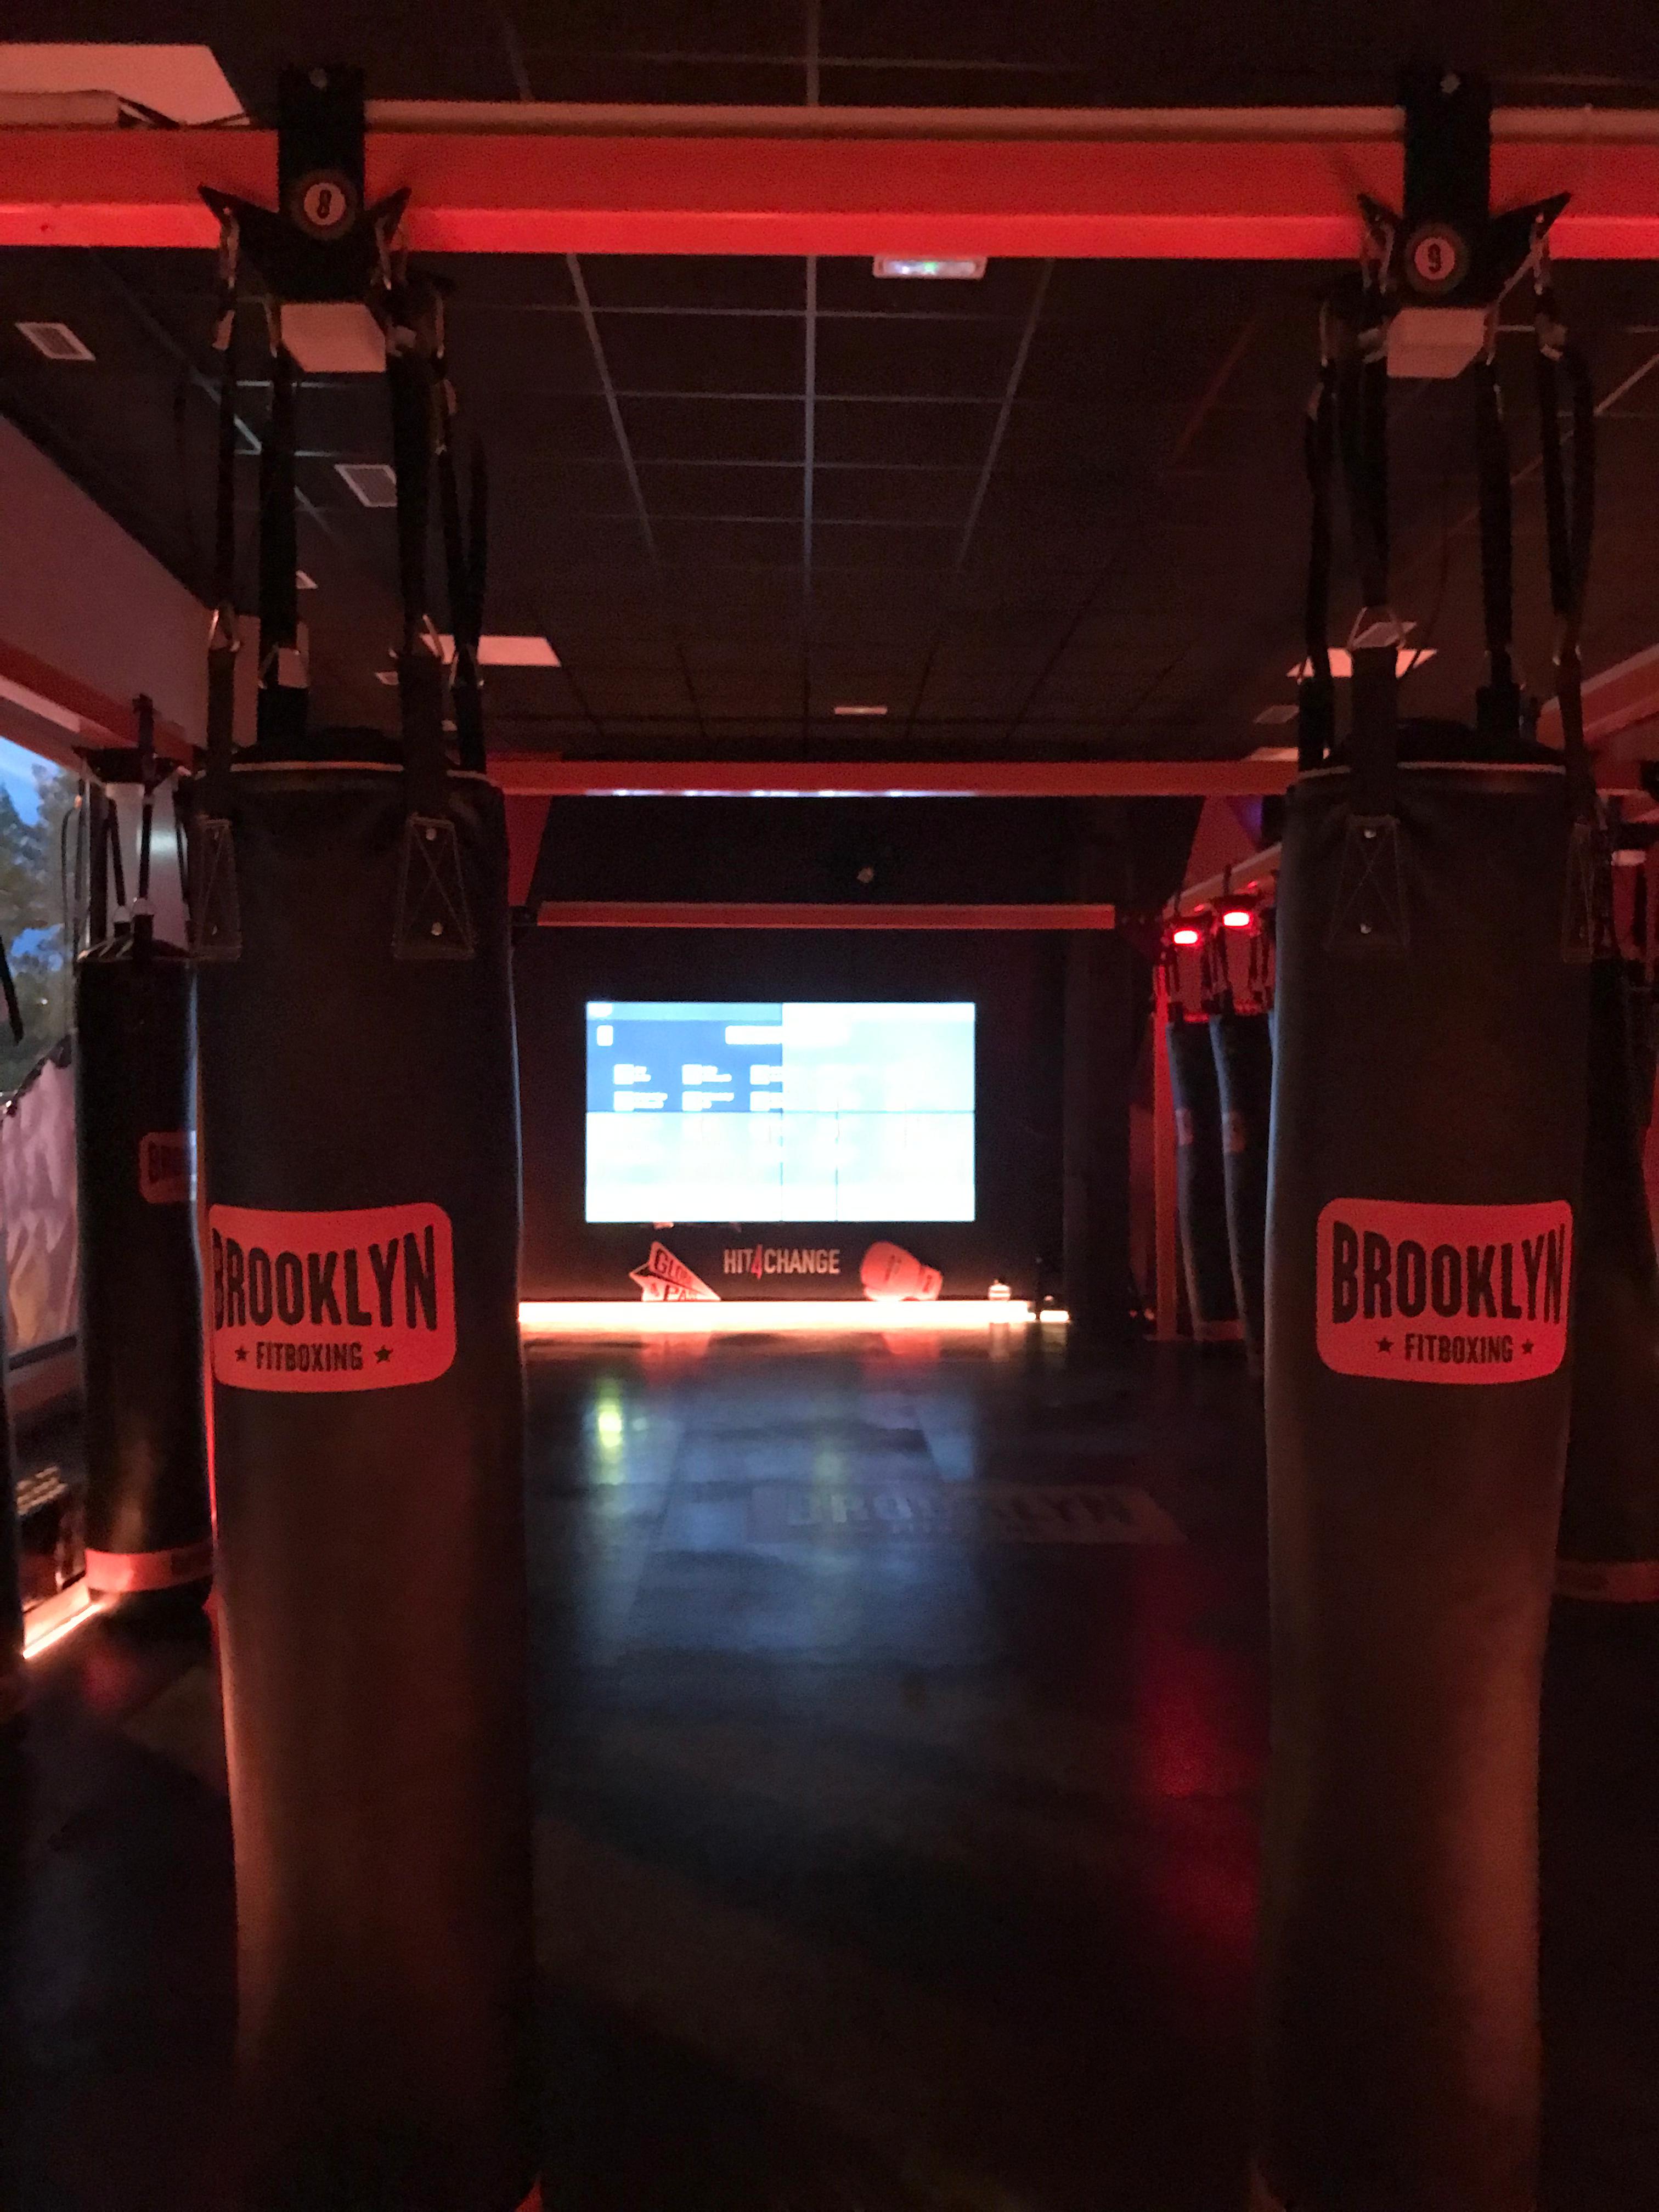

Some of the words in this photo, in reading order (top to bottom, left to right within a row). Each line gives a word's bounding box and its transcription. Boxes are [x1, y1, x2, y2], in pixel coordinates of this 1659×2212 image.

[317, 189, 332, 219] 8
[1427, 242, 1442, 273] 9
[724, 1243, 840, 1280] HIT4CHANGE
[1333, 1220, 1565, 1324] BROOKLYN
[256, 1341, 364, 1372] FITBOXING
[1405, 1333, 1514, 1363] FITBOXING
